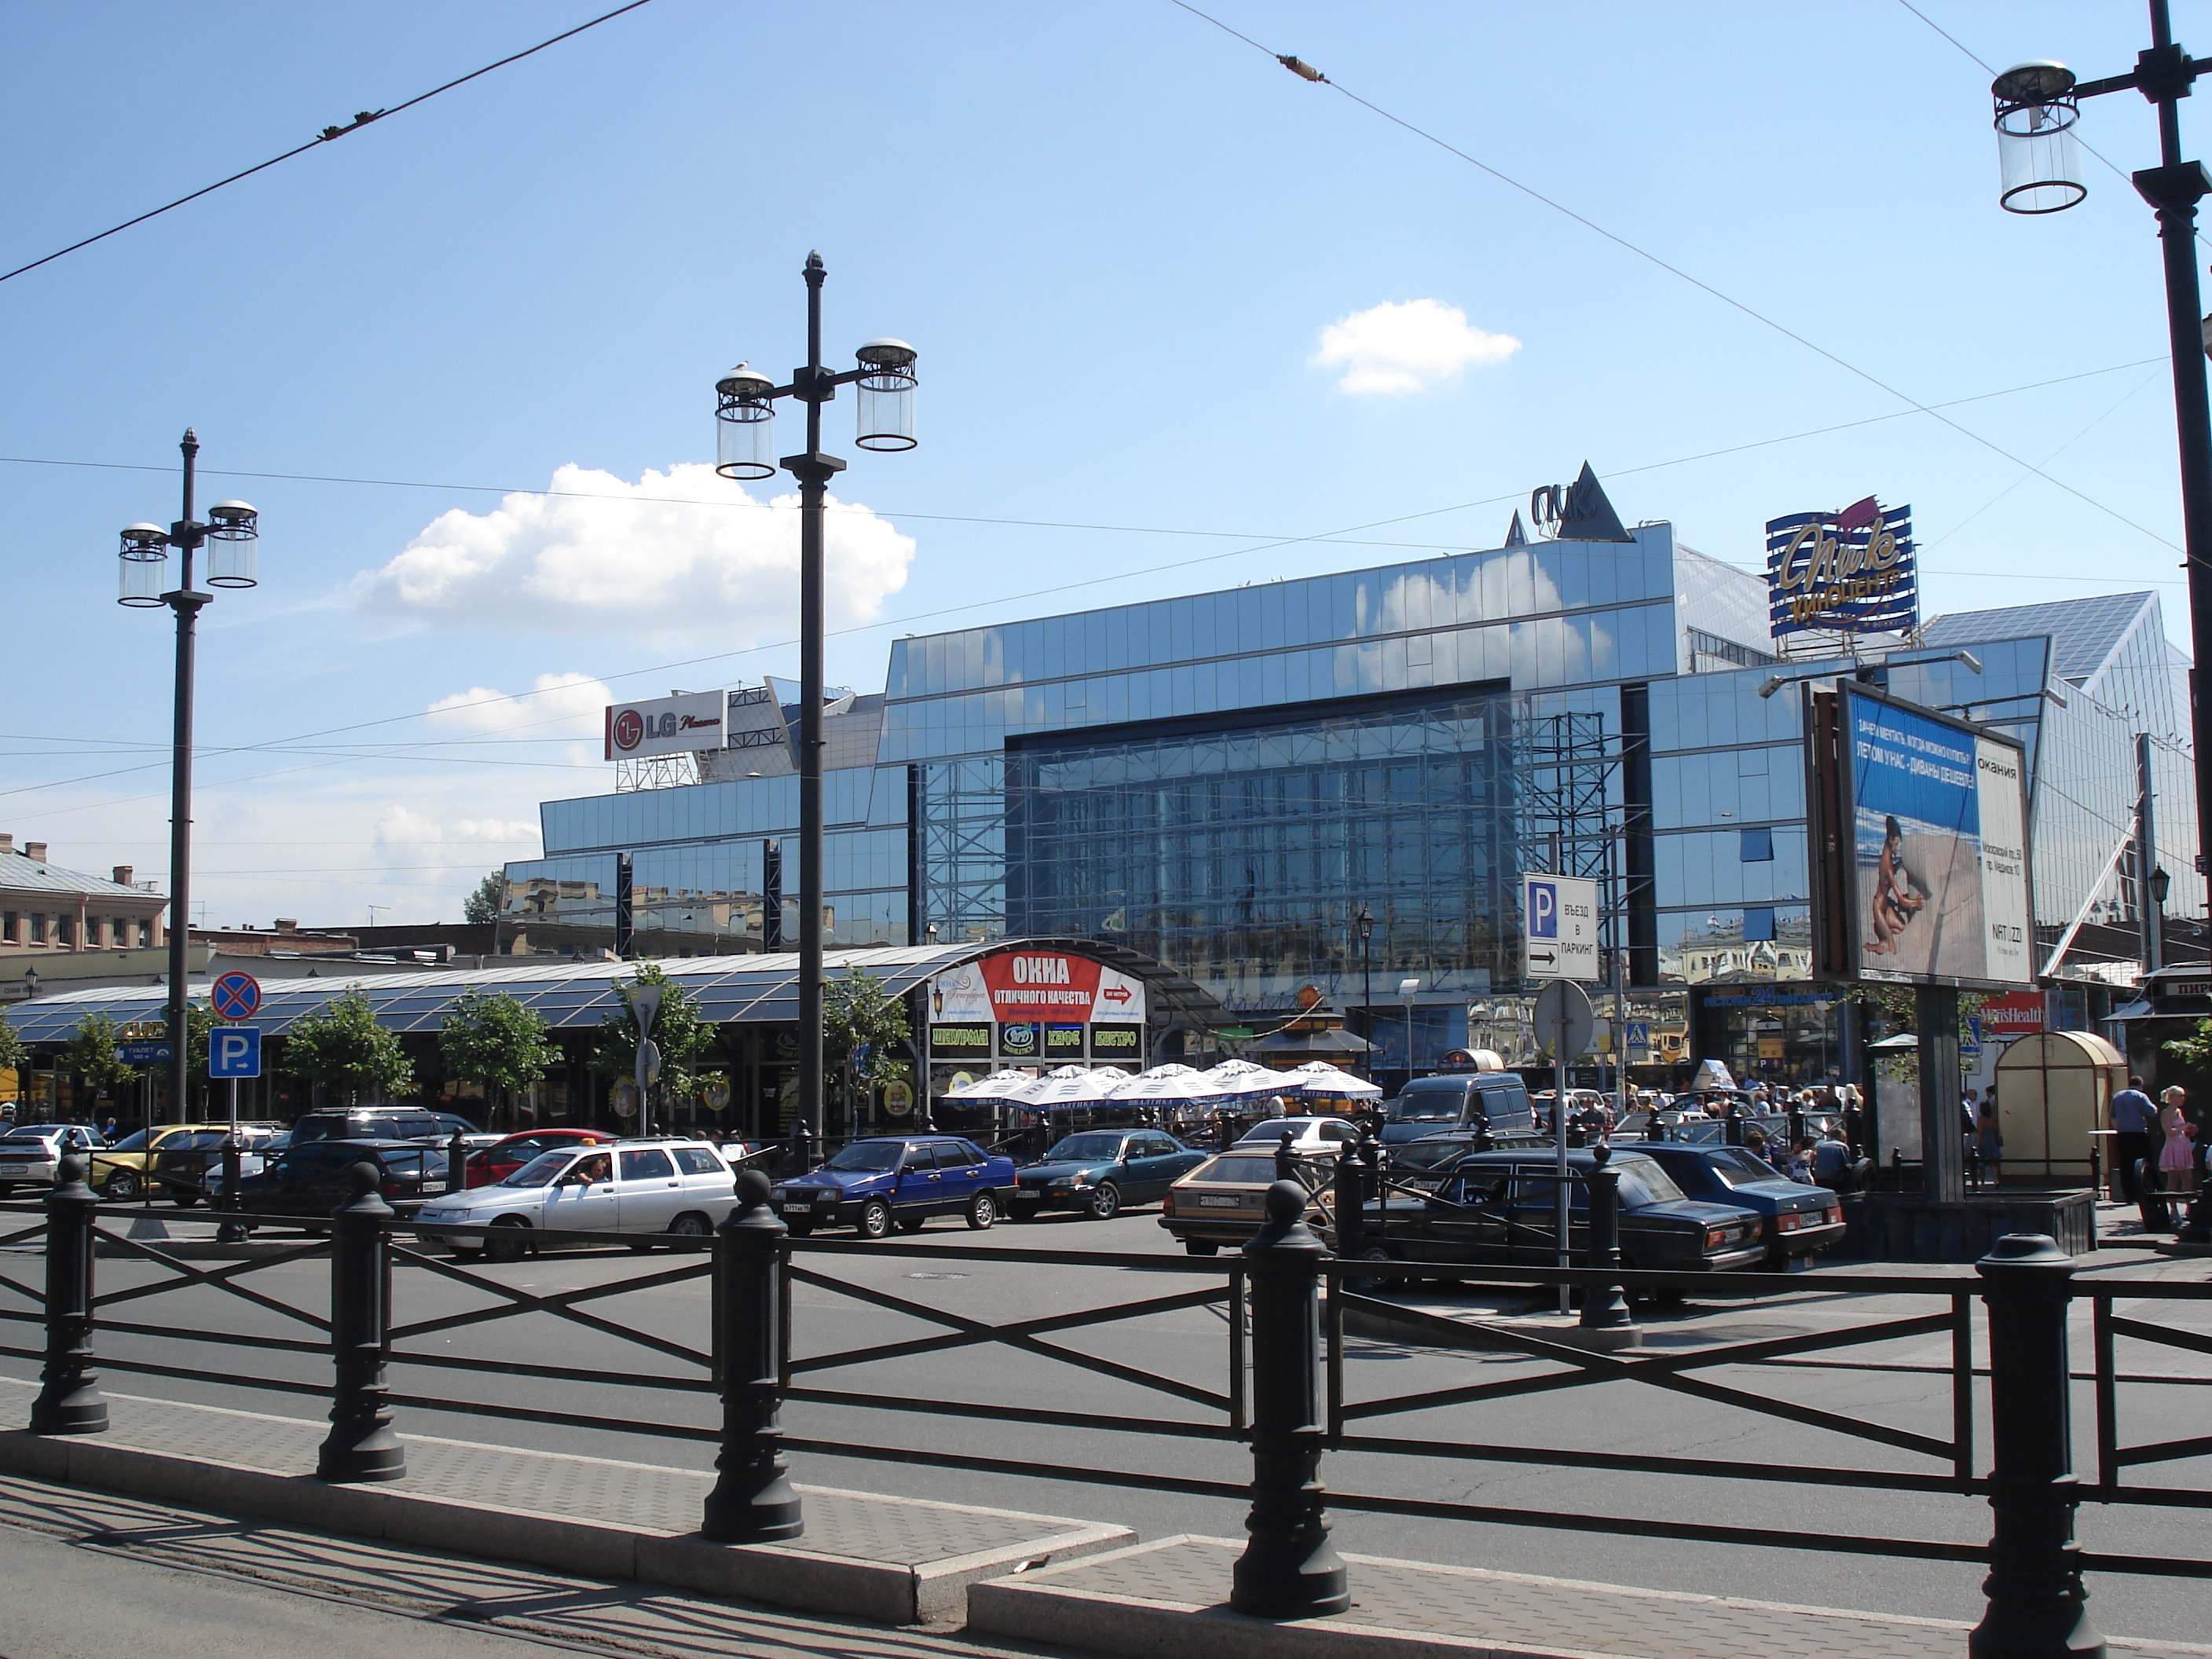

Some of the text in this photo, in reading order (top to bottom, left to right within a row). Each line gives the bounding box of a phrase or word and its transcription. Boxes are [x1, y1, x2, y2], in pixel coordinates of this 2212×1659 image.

[1792, 569, 1901, 624] КИНОЦЕНТР
[646, 712, 720, 739] LG Plasma
[1857, 741, 1884, 764] ЛЕТОМ
[1890, 751, 1905, 769] НАС
[1910, 757, 1939, 779] ДИВАНЫ
[1978, 758, 2016, 779] окания
[1565, 904, 1588, 919] ВЪЕЗД
[1575, 925, 1580, 936] В
[1561, 943, 1594, 955] ПАРКИНГ
[1013, 956, 1070, 983] ОКНА
[1751, 986, 1775, 1006] 24
[2178, 983, 2212, 994] ПИР
[994, 990, 1090, 1005] ОТЛИЧНОГО КАЧЕСТВА
[932, 1027, 989, 1046] ШАУРМА
[1047, 1030, 1081, 1046] КАФЕ
[1095, 1031, 1137, 1046] БИСТРО
